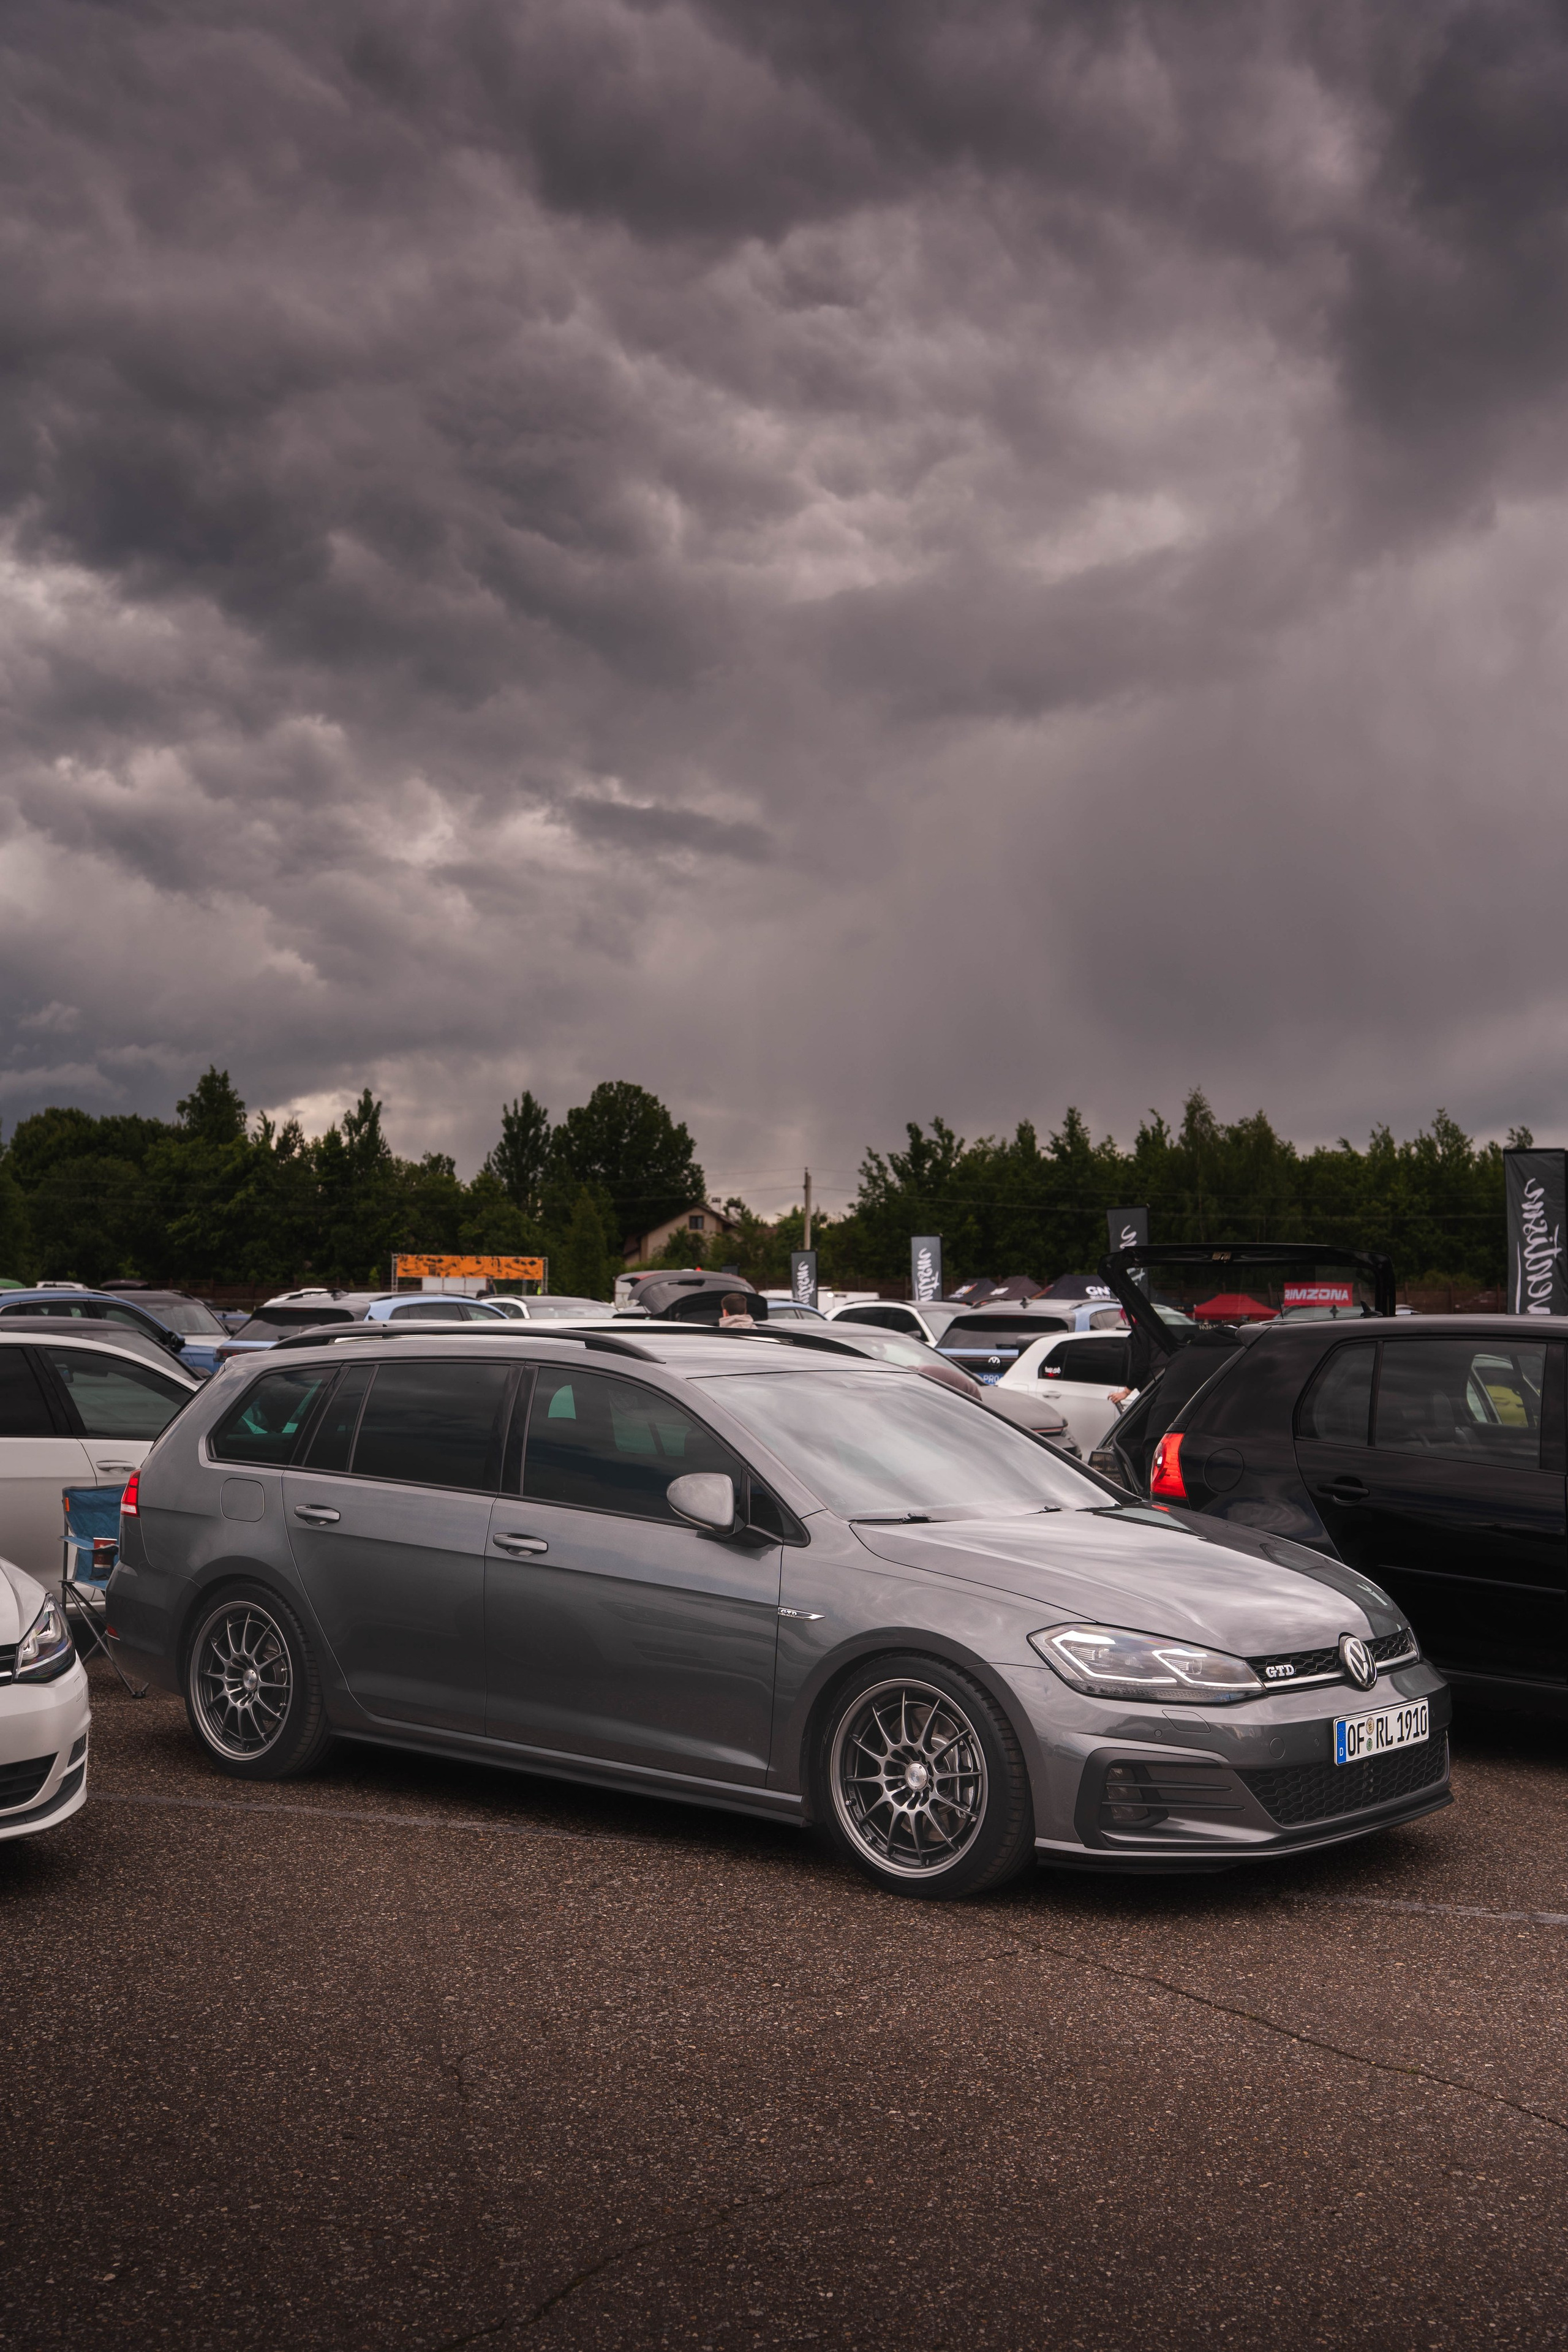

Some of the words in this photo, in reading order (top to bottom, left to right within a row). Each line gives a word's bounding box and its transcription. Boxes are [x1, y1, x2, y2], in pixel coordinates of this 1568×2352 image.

[1284, 1288, 1349, 1301] RIMZONA
[1265, 1664, 1295, 1678] GTD
[1348, 1722, 1365, 1757] OF
[1376, 1716, 1393, 1749] RL
[1396, 1705, 1427, 1743] 1910
[1339, 1747, 1344, 1757] D
